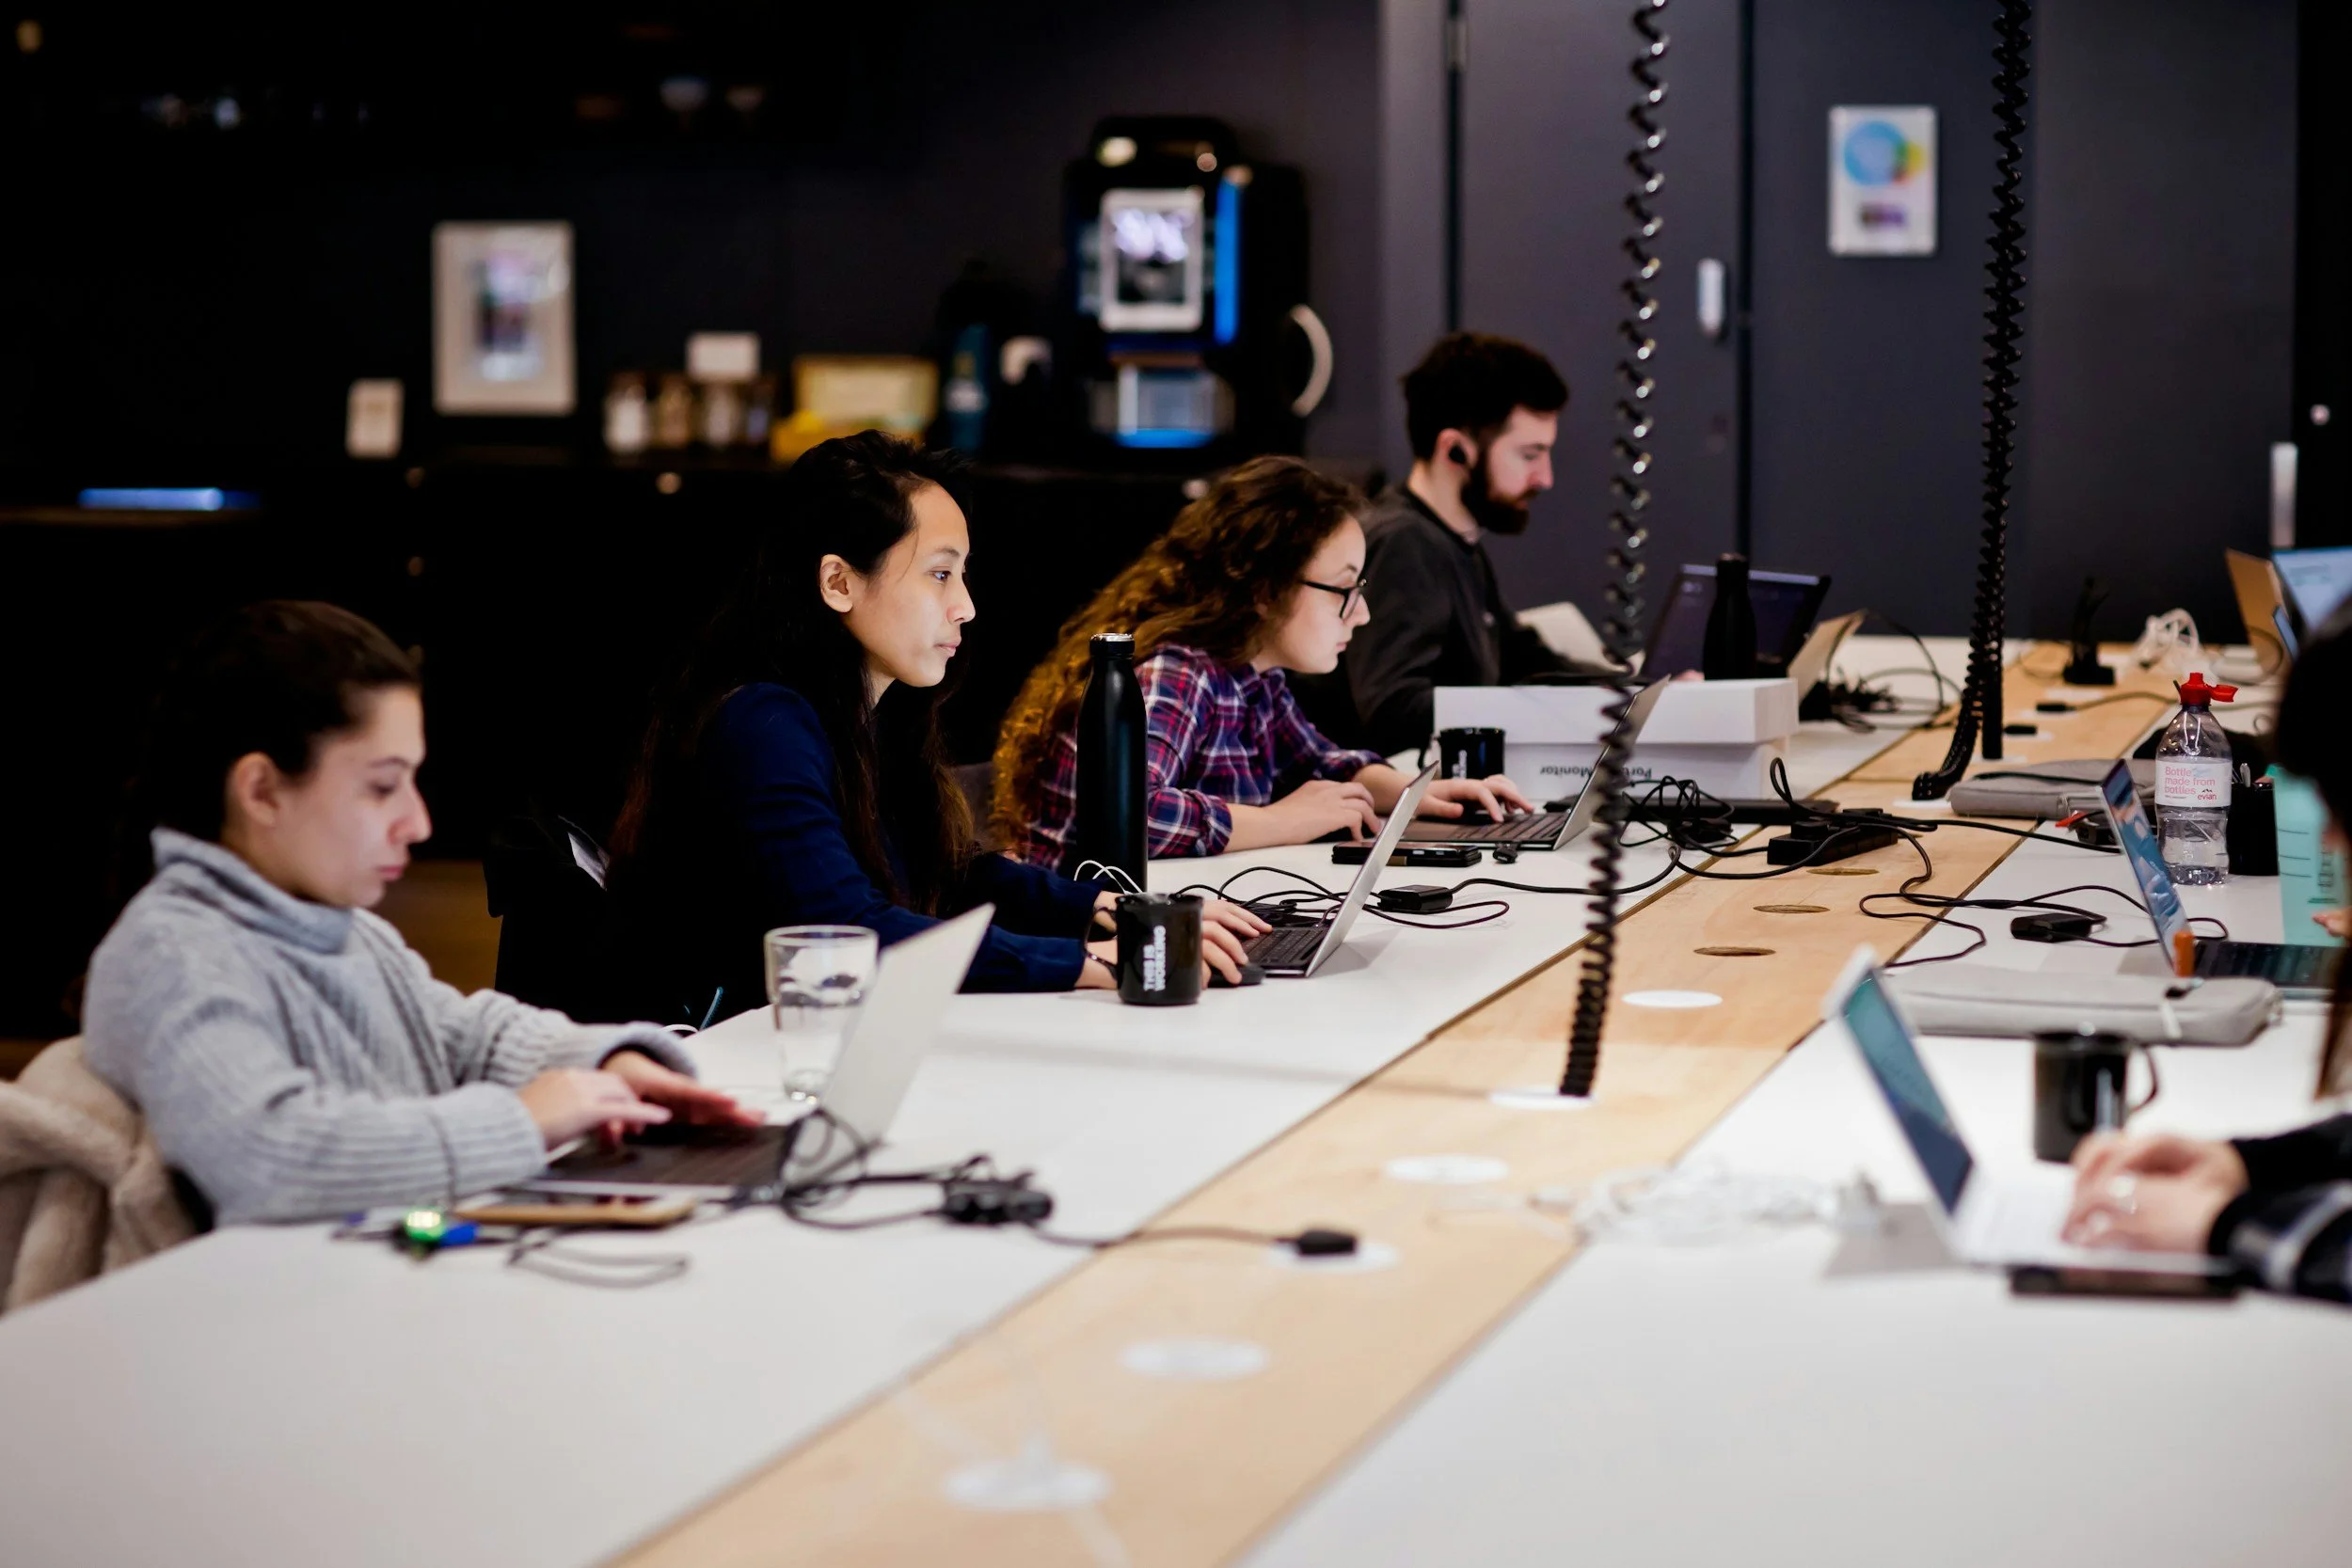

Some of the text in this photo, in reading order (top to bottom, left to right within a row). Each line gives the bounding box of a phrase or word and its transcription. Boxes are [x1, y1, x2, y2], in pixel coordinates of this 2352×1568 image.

[2165, 767, 2191, 776] Bottle
[2165, 777, 2216, 786] made from
[2165, 786, 2196, 795] bottles
